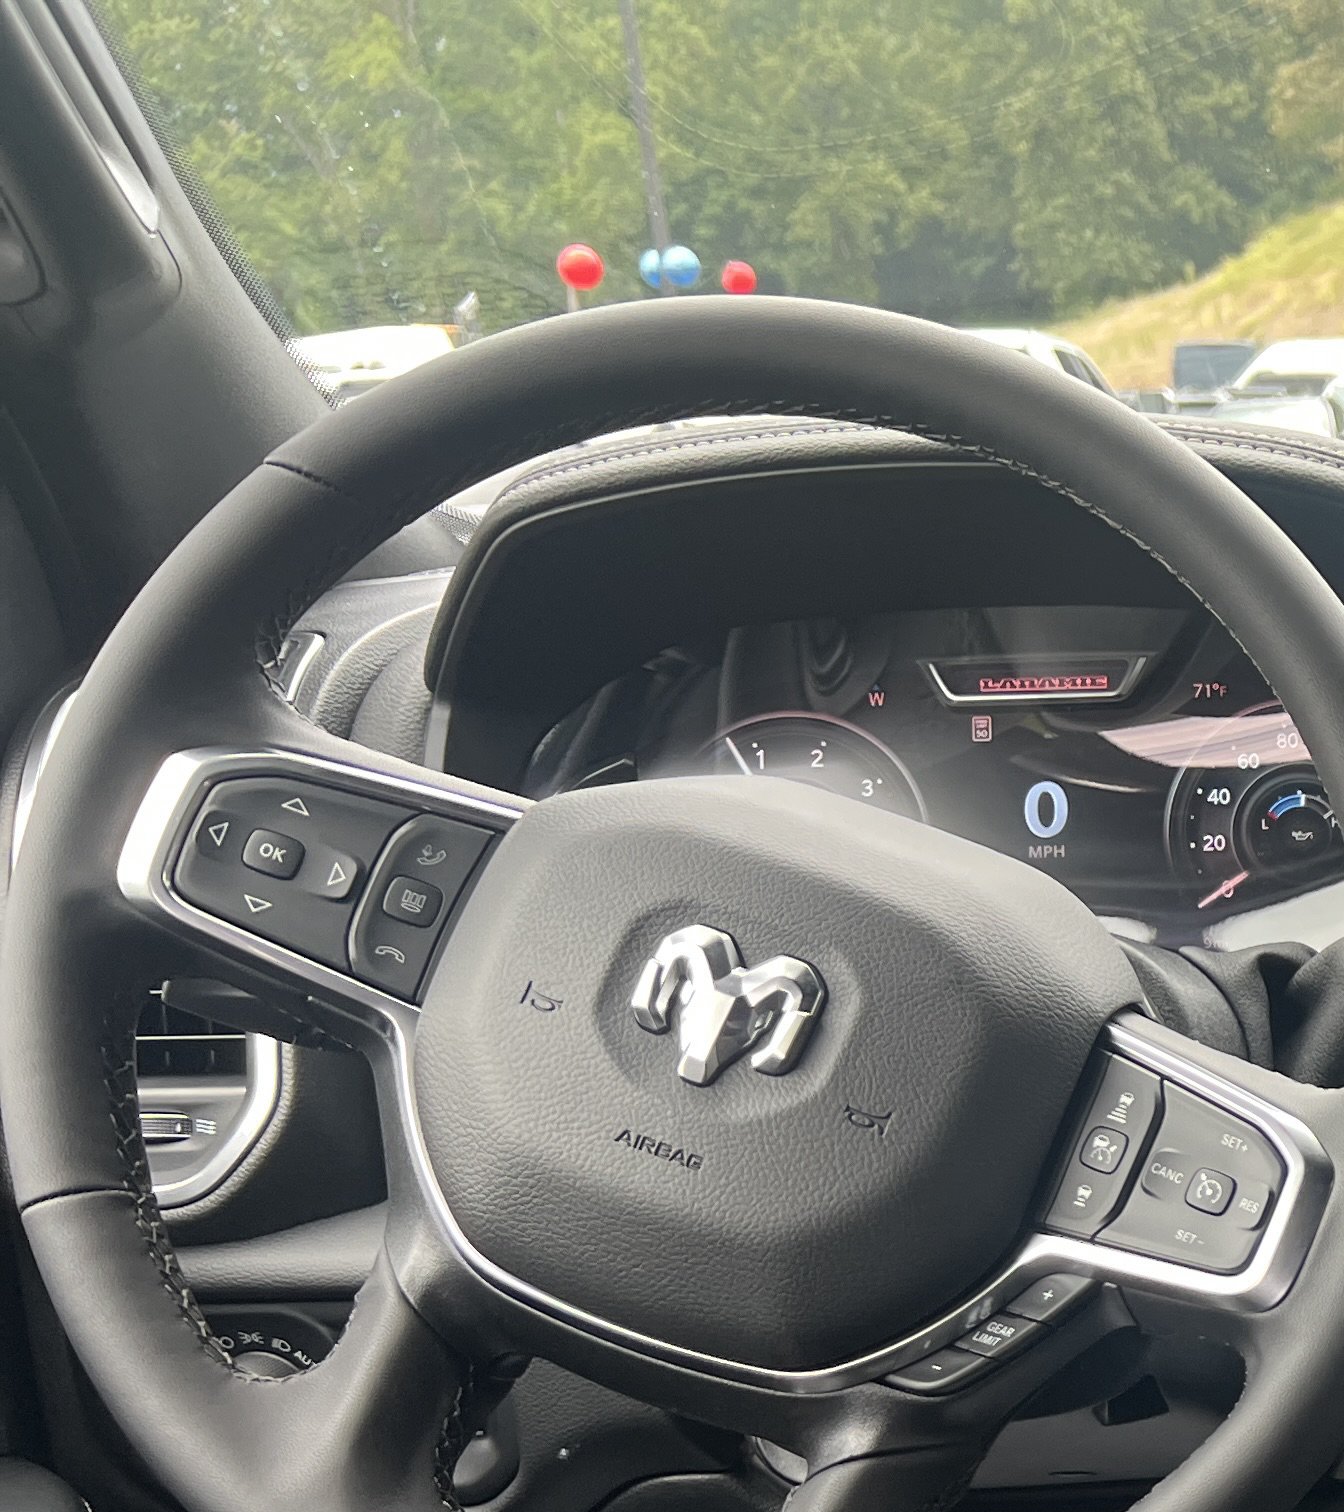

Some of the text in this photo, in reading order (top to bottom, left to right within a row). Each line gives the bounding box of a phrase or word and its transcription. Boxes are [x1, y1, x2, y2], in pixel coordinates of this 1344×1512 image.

[869, 692, 884, 706] W
[1277, 733, 1299, 748] 80
[756, 750, 765, 769] 1
[811, 750, 824, 768] 2
[1237, 753, 1260, 769] 60
[861, 779, 874, 797] 3
[1207, 788, 1230, 805] 40
[1024, 780, 1068, 838] 0
[1028, 845, 1065, 859] MPH
[1202, 835, 1226, 852] 20
[259, 843, 286, 863] OK
[614, 1129, 704, 1170] AIRBAG
[1151, 1163, 1184, 1186] CANC
[1239, 1197, 1259, 1215] RES
[987, 1321, 1014, 1338] GEAR
[973, 1331, 1001, 1347] LIMIT
